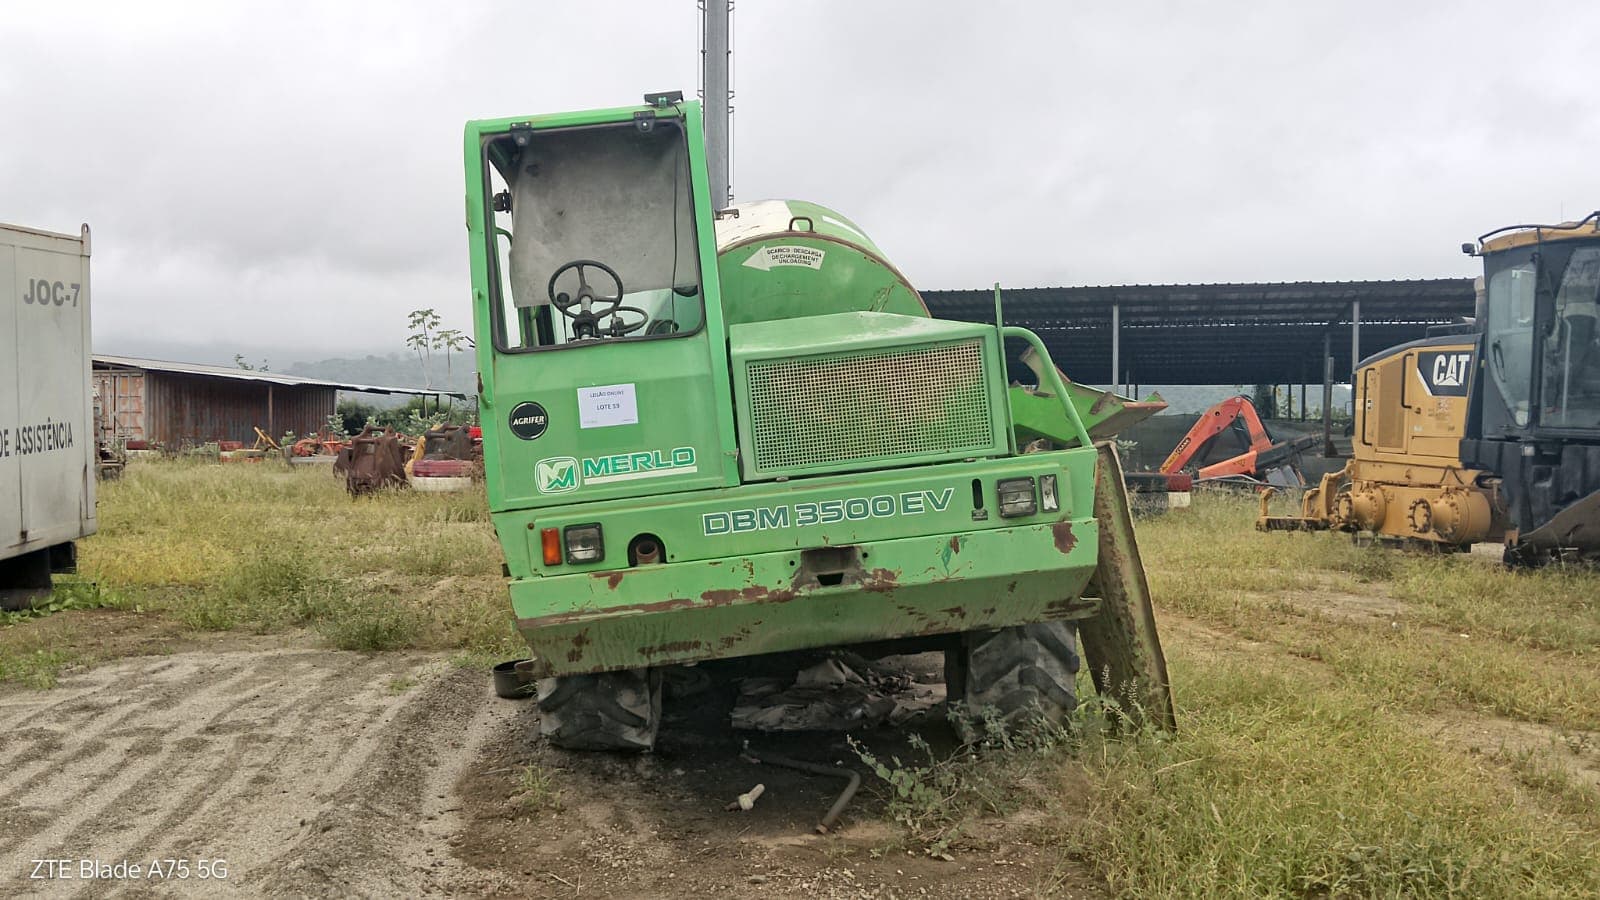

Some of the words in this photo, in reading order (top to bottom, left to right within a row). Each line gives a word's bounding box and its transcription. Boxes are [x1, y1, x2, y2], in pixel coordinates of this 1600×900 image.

[23, 278, 81, 307] JOC-7
[1433, 354, 1470, 387] CAT
[15, 416, 74, 456] ASSISTÊNCIA
[512, 415, 545, 426] AGRIFER
[582, 446, 697, 478] MERLO
[703, 505, 790, 536] DBM
[795, 494, 896, 527] 3500
[900, 487, 955, 516] EV
